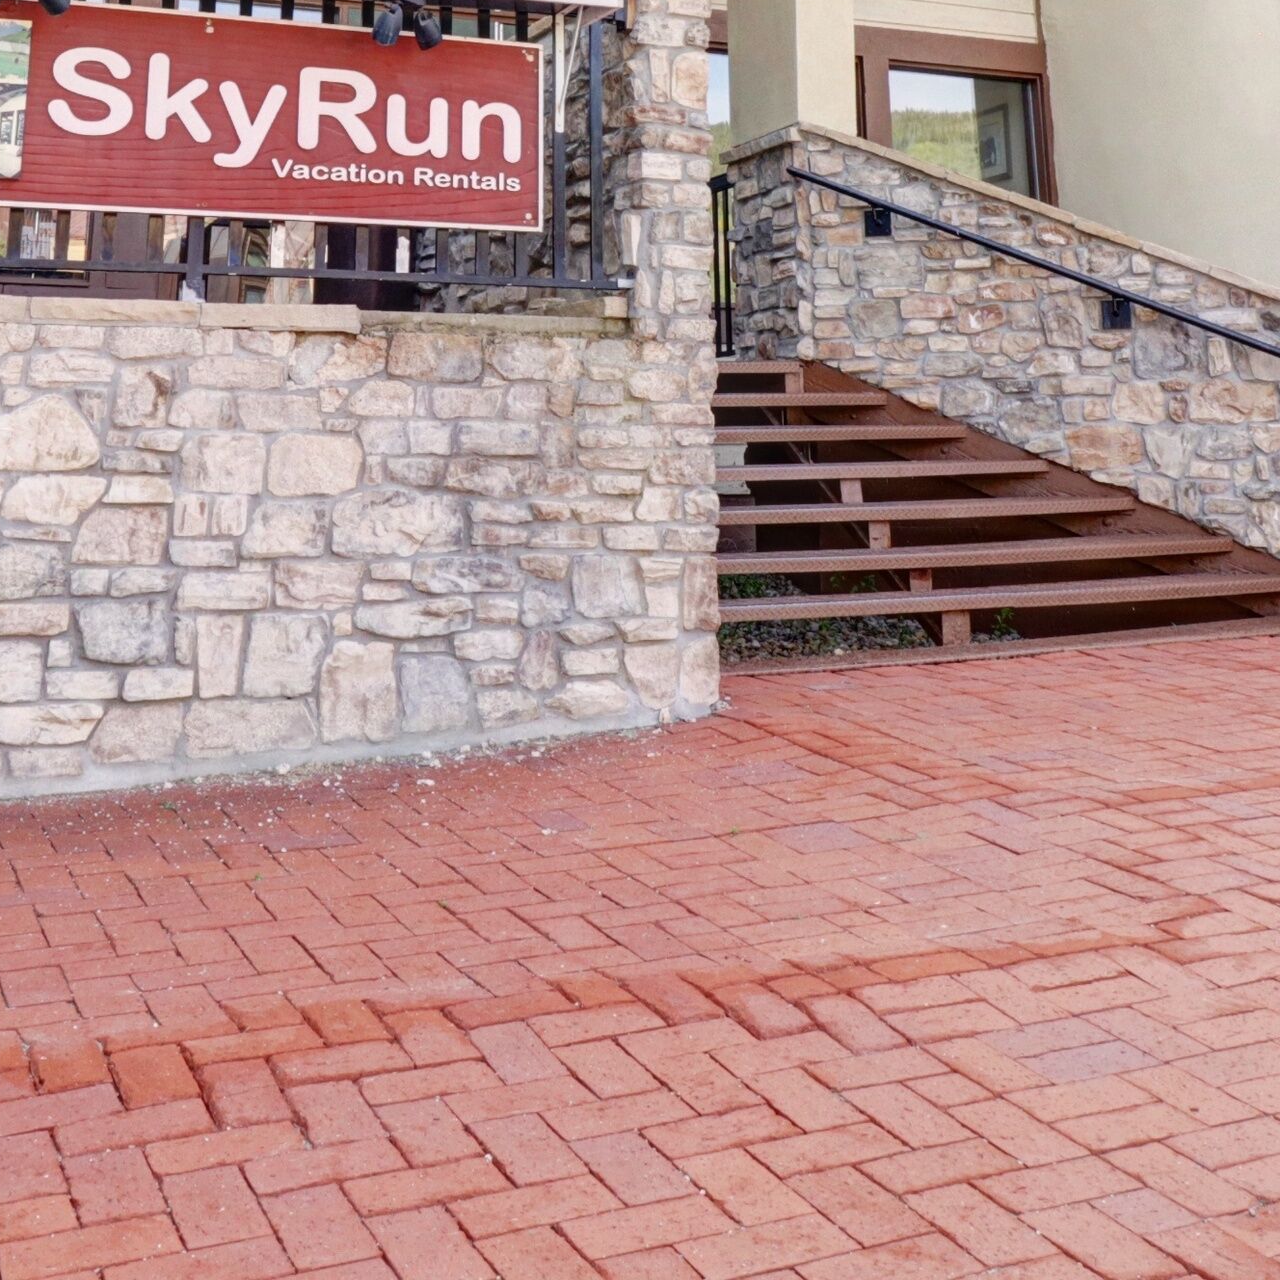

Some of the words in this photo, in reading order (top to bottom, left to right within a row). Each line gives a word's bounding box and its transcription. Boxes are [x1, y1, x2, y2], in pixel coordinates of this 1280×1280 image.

[47, 45, 523, 168] SkyRun
[271, 157, 404, 186] Vacation
[414, 166, 522, 193] Rentals
